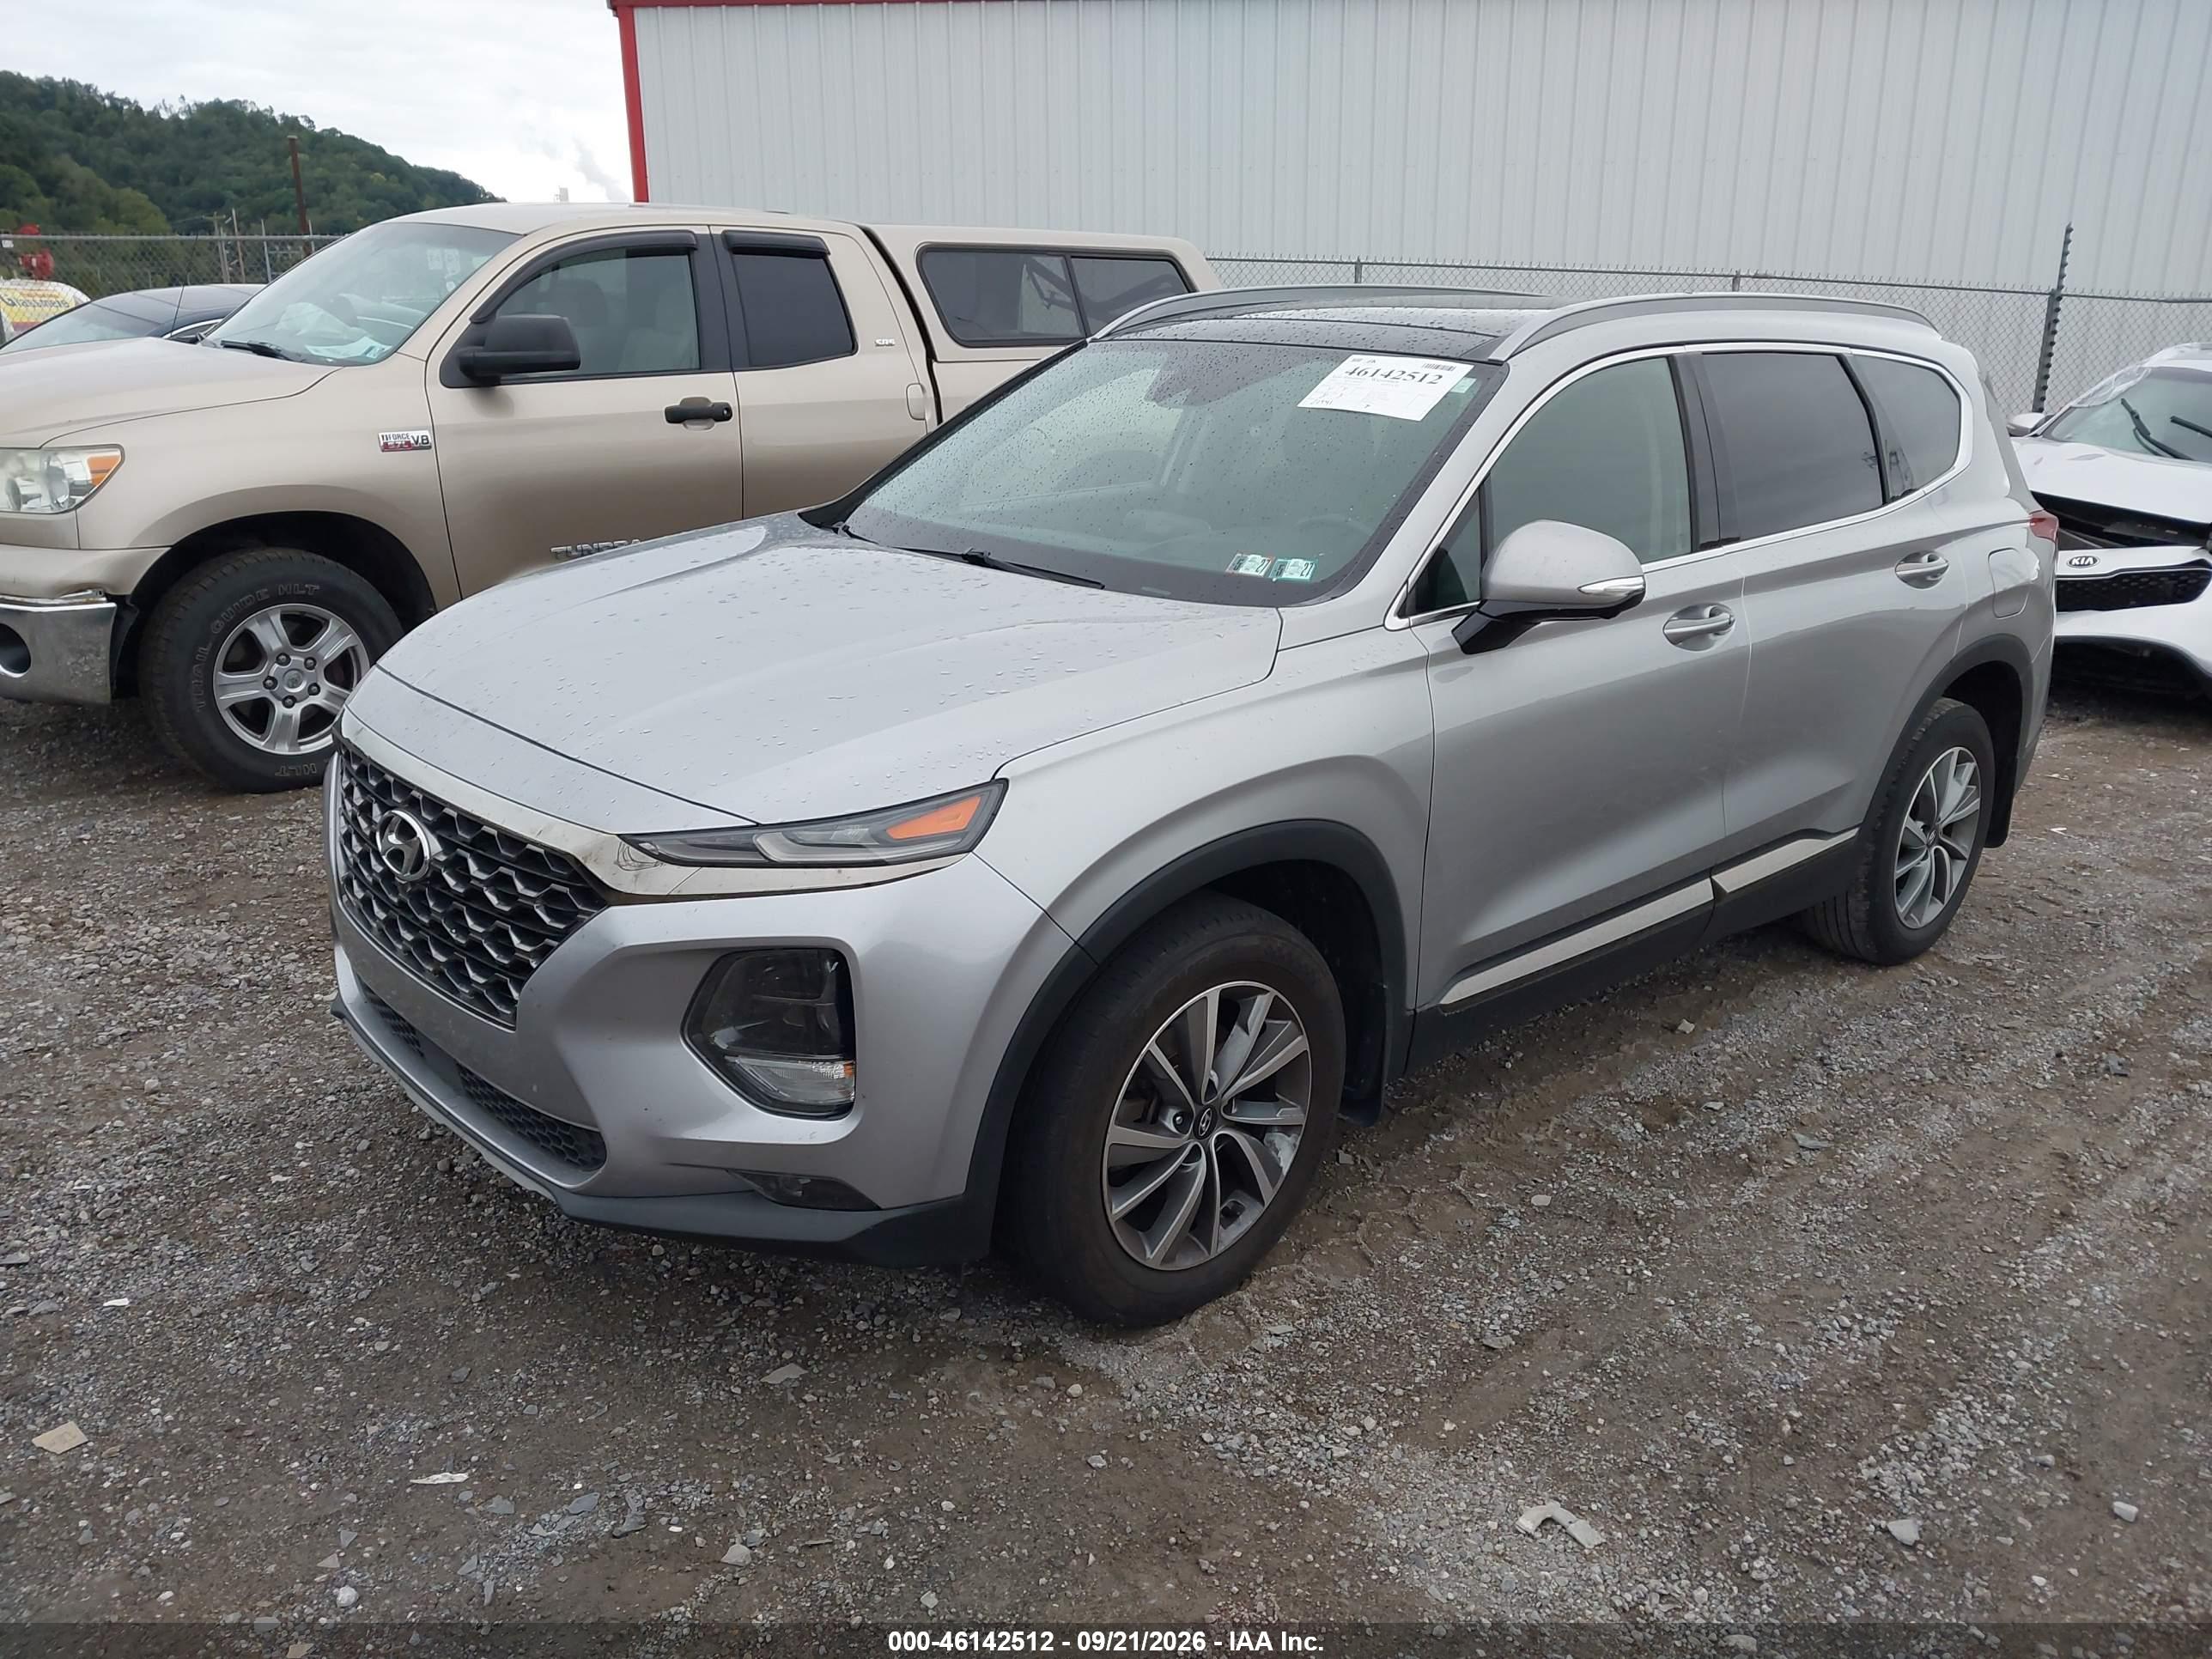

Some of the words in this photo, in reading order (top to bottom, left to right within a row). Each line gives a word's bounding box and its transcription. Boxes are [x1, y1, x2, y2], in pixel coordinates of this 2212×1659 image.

[1345, 366, 1444, 385] 46142512
[412, 434, 429, 445] V8
[2070, 556, 2094, 566] KIA
[1300, 562, 1314, 577] 27
[210, 587, 270, 635] GUIDE
